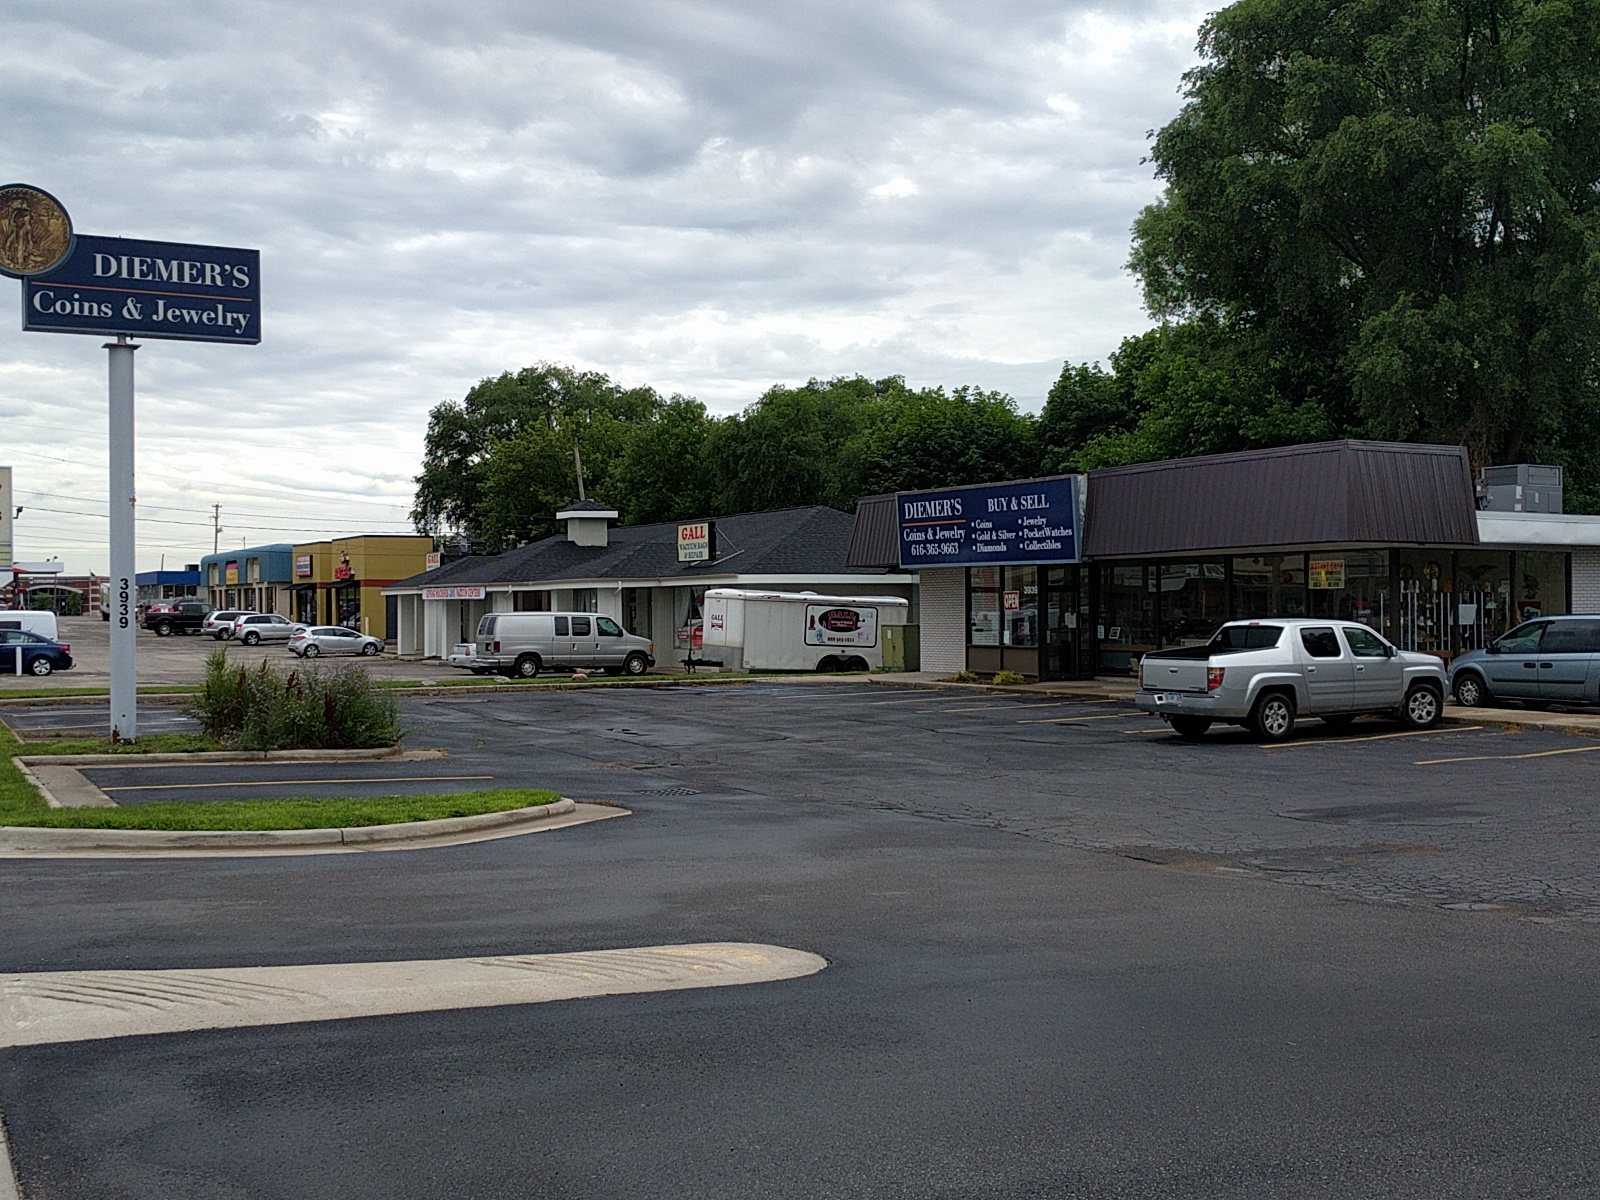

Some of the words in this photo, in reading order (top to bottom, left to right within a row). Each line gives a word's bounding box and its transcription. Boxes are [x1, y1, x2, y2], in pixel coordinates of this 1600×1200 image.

[93, 253, 249, 288] DIEMER'S
[33, 290, 112, 318] Coins
[122, 297, 143, 320] &
[152, 299, 251, 334] Jewelry
[904, 498, 963, 519] DIEMER'S
[987, 497, 1008, 513] BUY
[1010, 496, 1018, 511] &
[1020, 493, 1050, 510] SELL
[975, 519, 993, 529] Coins
[1022, 515, 1047, 528] Jewelry
[681, 525, 706, 541] GALL
[903, 528, 926, 542] Coins
[927, 527, 934, 540] &
[935, 525, 966, 543] Jewelry
[976, 530, 991, 541] Gold
[991, 530, 997, 540] &
[997, 529, 1017, 540] Silver
[911, 542, 960, 556] 616-365-9663
[976, 541, 1007, 553] Diamonds
[1024, 539, 1062, 551] Collectibles
[1023, 585, 1038, 595] 3939
[119, 577, 129, 629] 3939
[1004, 593, 1018, 609] OPEN
